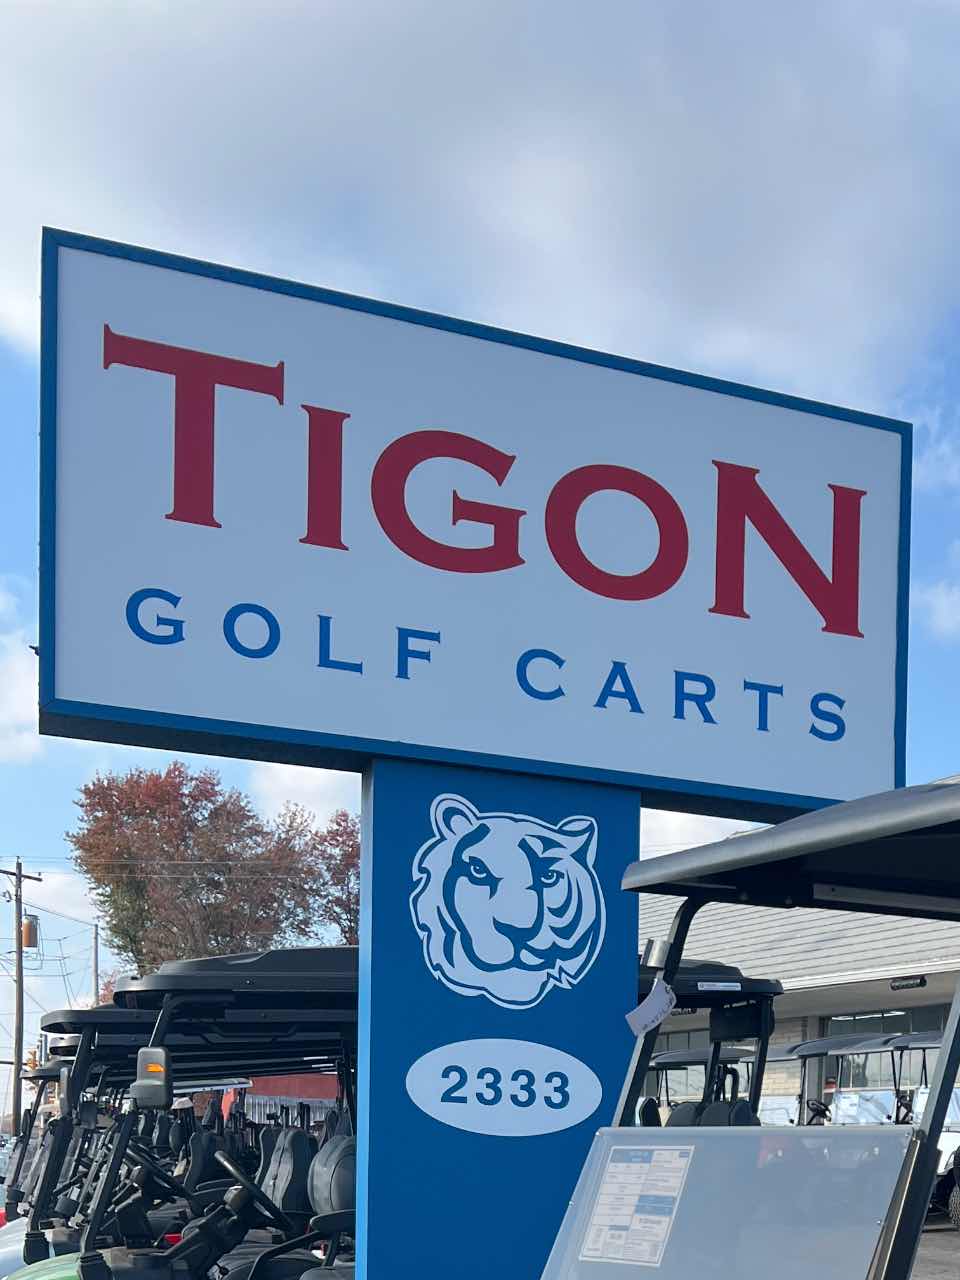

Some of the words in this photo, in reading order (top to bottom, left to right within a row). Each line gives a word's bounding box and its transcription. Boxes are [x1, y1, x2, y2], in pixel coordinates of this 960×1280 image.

[103, 323, 866, 638] TIGON
[125, 587, 441, 681] GOLF
[515, 648, 848, 742] CARTS
[440, 1064, 570, 1110] 2333
